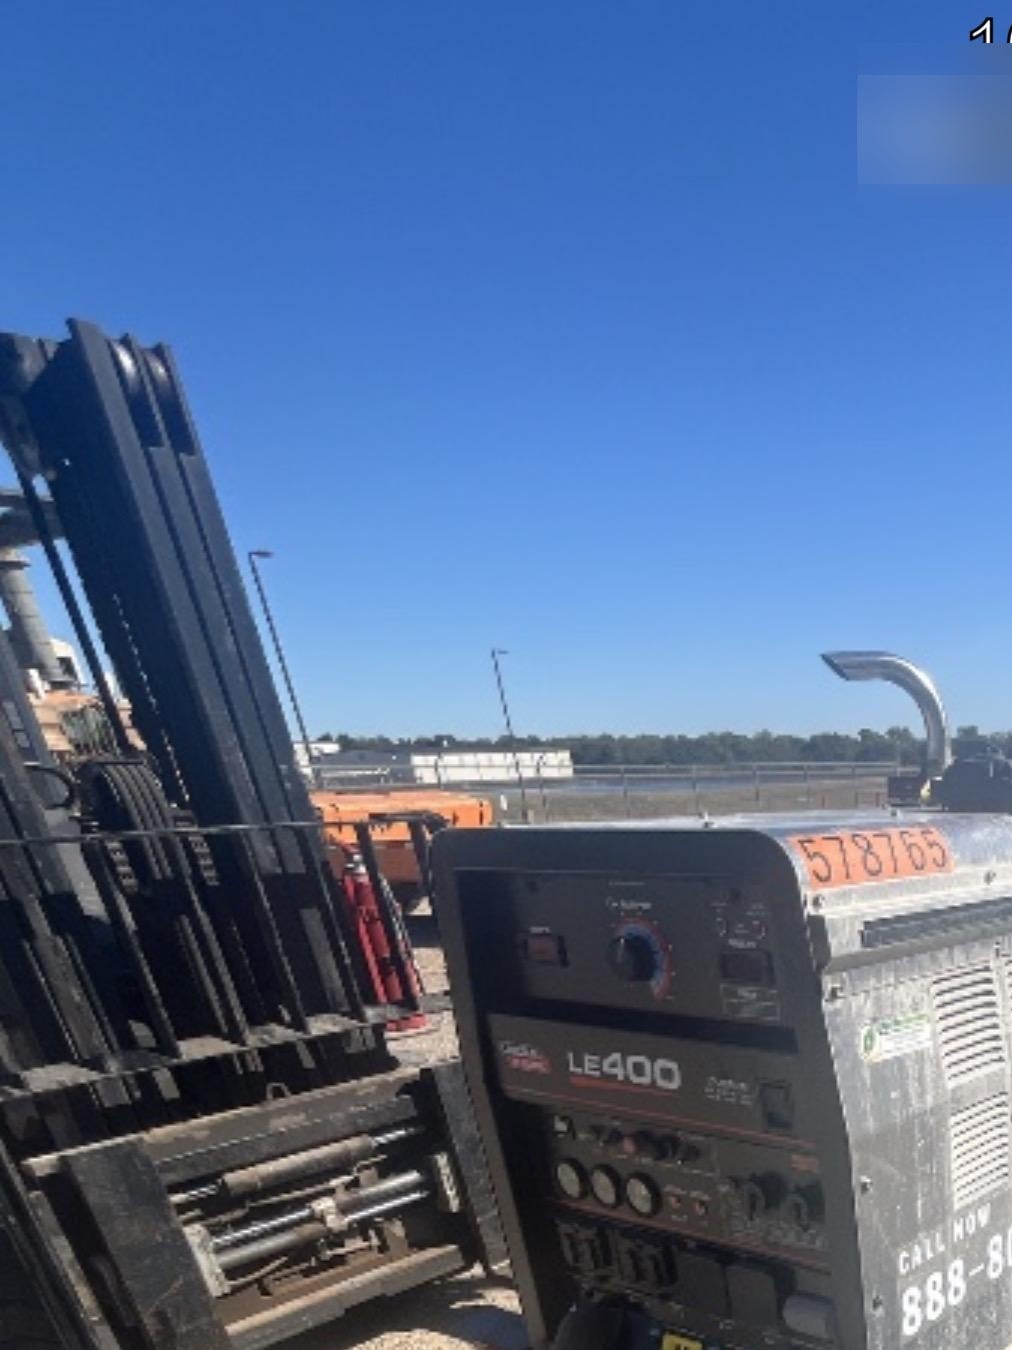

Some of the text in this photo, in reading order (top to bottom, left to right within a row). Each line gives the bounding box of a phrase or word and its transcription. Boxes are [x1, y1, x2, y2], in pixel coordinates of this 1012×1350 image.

[798, 829, 946, 882] 578765
[567, 1051, 682, 1090] LE400
[899, 1202, 992, 1275] CALL NOW
